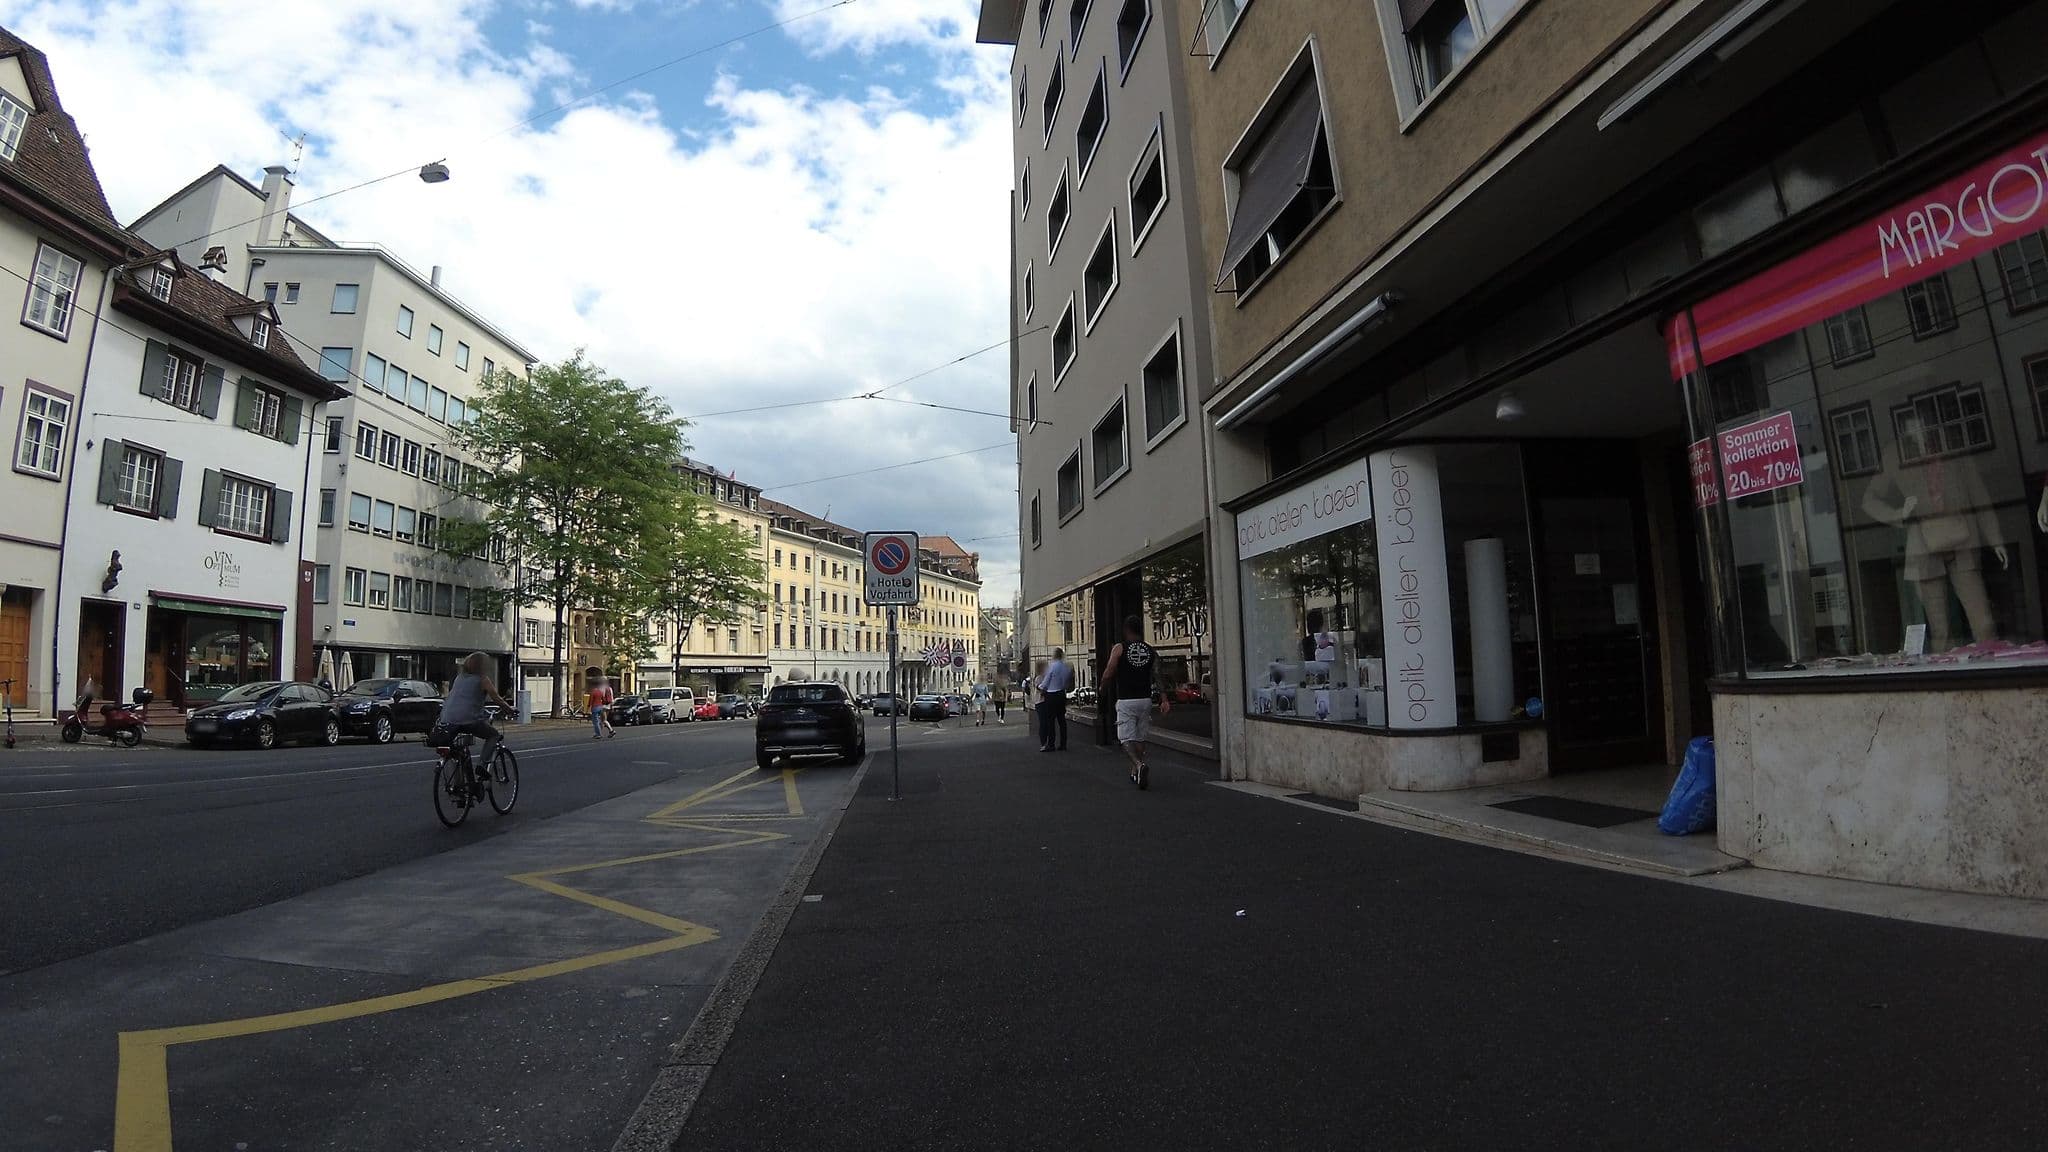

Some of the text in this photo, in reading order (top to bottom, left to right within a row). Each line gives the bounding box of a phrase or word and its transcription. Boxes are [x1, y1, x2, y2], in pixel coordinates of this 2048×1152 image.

[1724, 439, 1789, 465] kollektion
[1729, 461, 1800, 493] 20 bis 70%
[1268, 501, 1309, 536] atelier
[870, 589, 912, 600] Vorfahrt
[1395, 556, 1422, 644] atelier
[1400, 653, 1434, 721] optik
